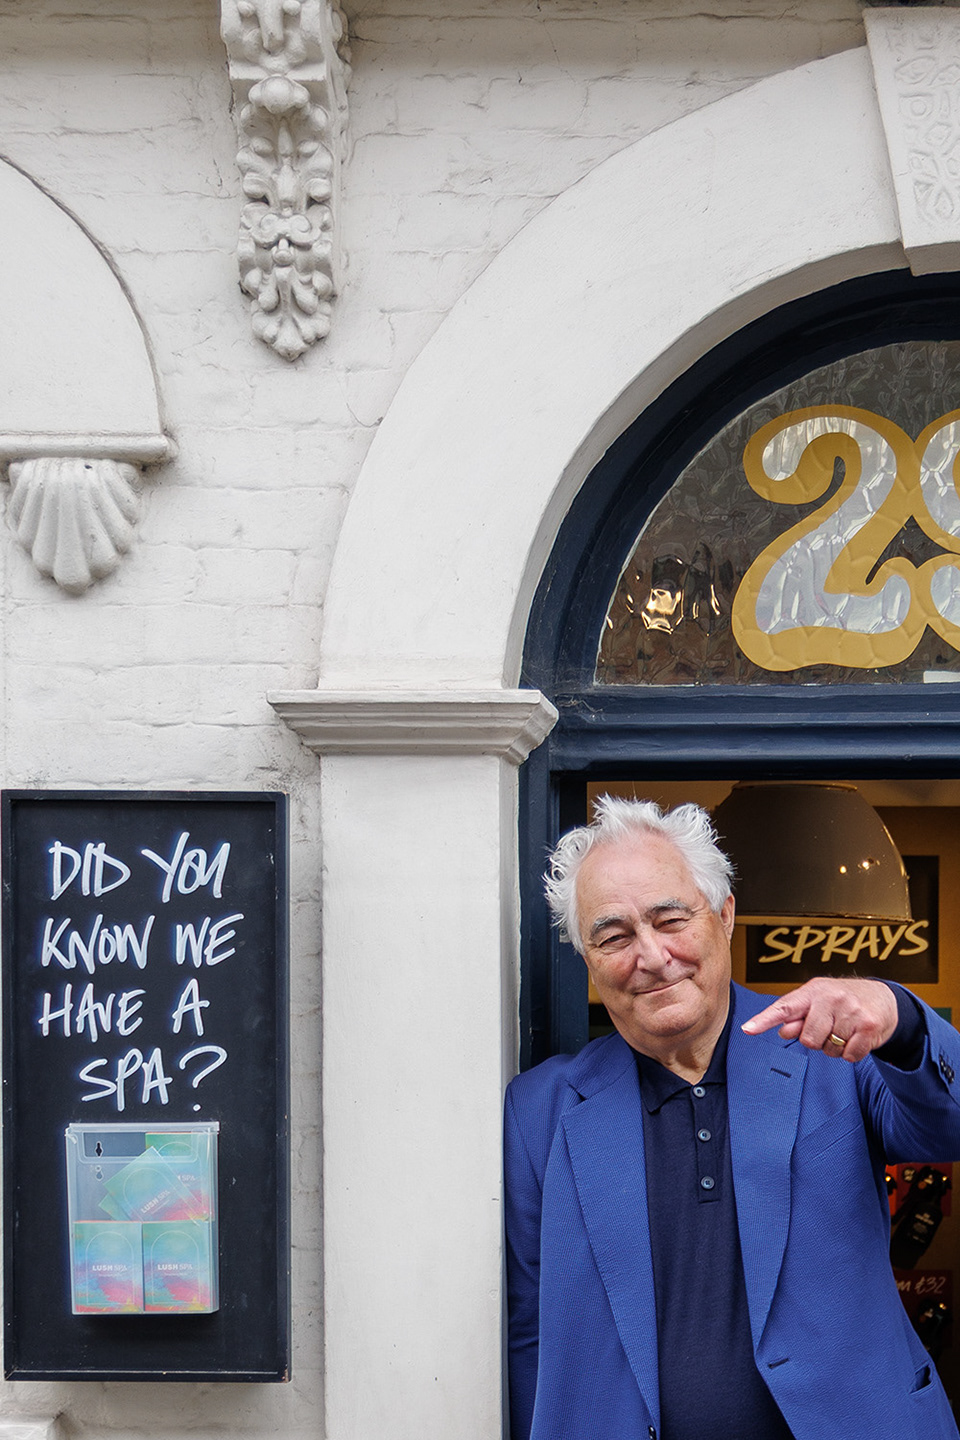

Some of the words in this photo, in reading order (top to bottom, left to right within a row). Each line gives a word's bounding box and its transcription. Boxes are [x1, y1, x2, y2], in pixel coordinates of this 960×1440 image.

[48, 840, 131, 900] DID
[141, 831, 231, 903] YOU
[41, 913, 156, 975] KNOW
[175, 913, 245, 969] WE
[758, 920, 930, 964] SPRAYS
[37, 982, 146, 1042] HAVE
[171, 978, 211, 1037] A
[78, 1044, 228, 1112] SPA?
[92, 1264, 113, 1272] LUSH
[157, 1263, 178, 1271] LUSH
